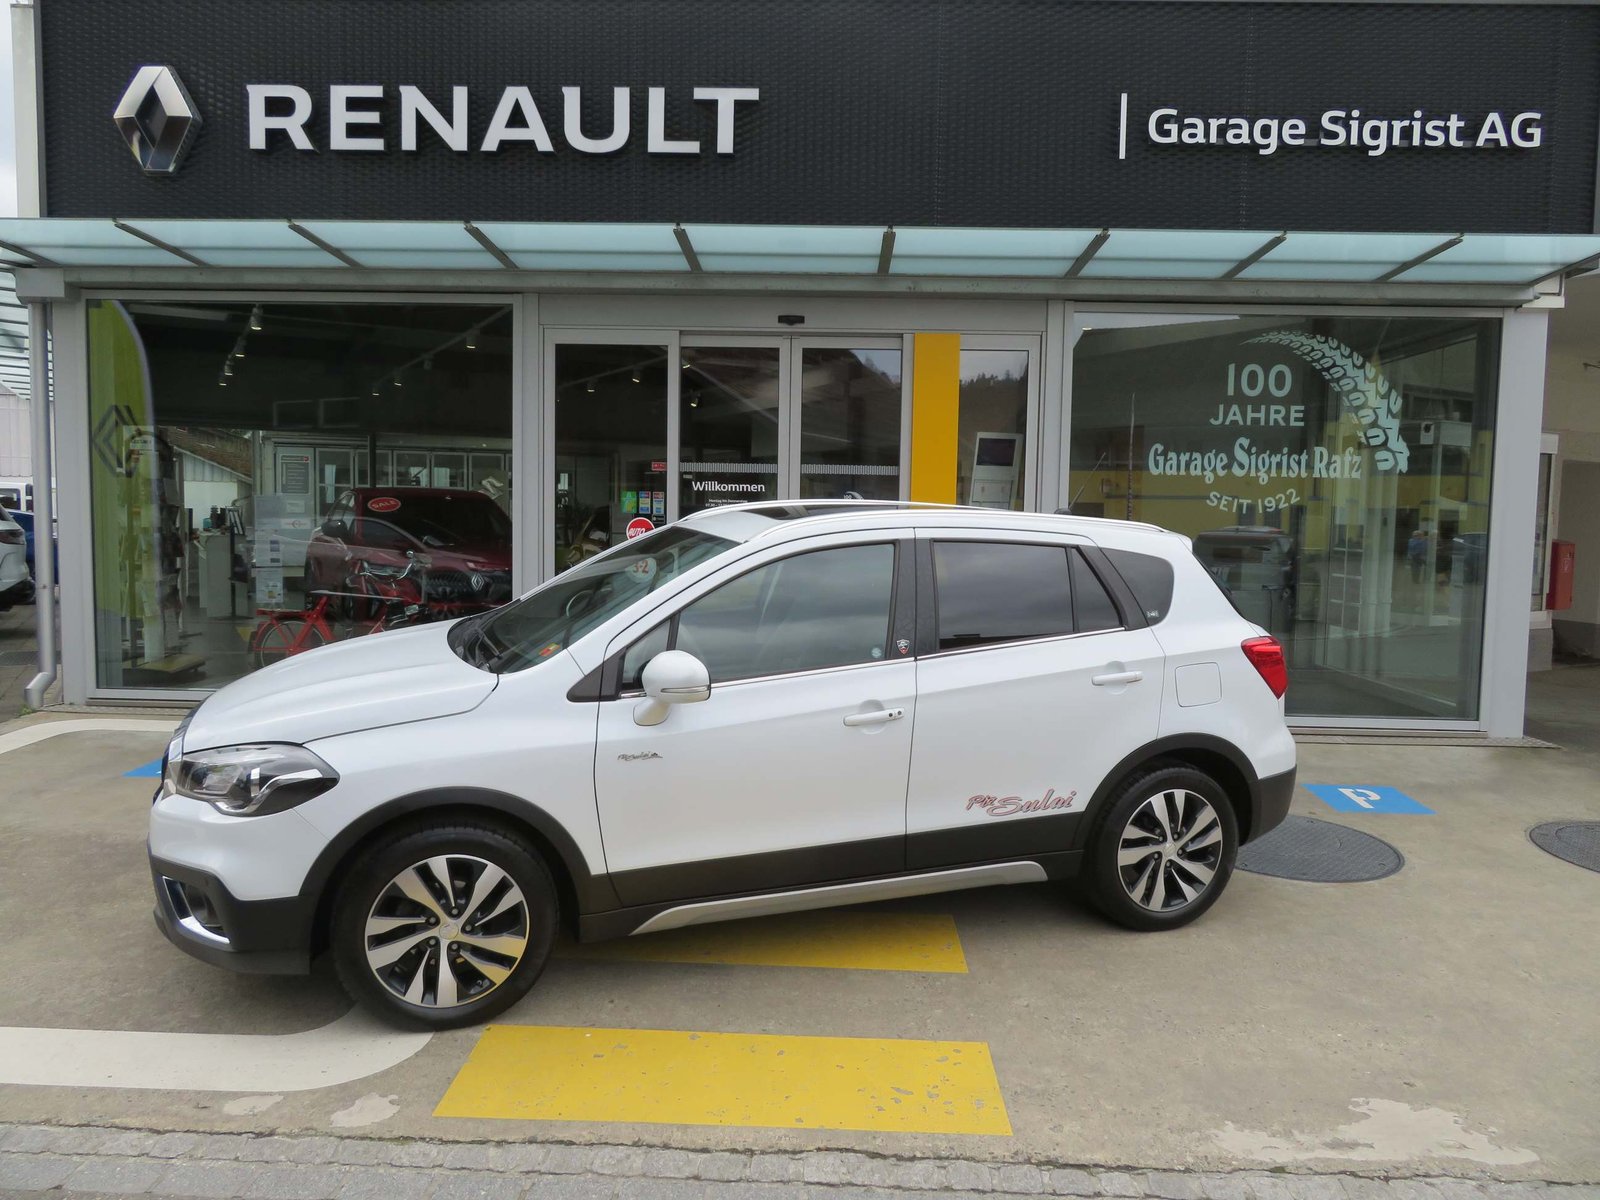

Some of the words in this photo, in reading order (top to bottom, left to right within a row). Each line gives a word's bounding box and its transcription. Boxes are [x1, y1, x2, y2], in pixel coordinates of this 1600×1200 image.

[246, 84, 760, 154] RENAULT
[1148, 107, 1306, 155] Garage
[1320, 109, 1464, 156] Sigrist
[1476, 111, 1542, 148] AG
[1226, 363, 1292, 398] 100
[1209, 404, 1305, 427] JAHRE
[1148, 443, 1228, 484] Garage
[1231, 437, 1308, 485] Sigrist
[1312, 446, 1362, 480] Rafz
[692, 481, 766, 492] Willkommen
[371, 500, 397, 508] SALE
[1206, 491, 1252, 514] SEIT
[1257, 488, 1300, 514] 1922
[966, 794, 998, 811] Piz
[986, 788, 1078, 817] Sulai
[1337, 788, 1381, 809] P
